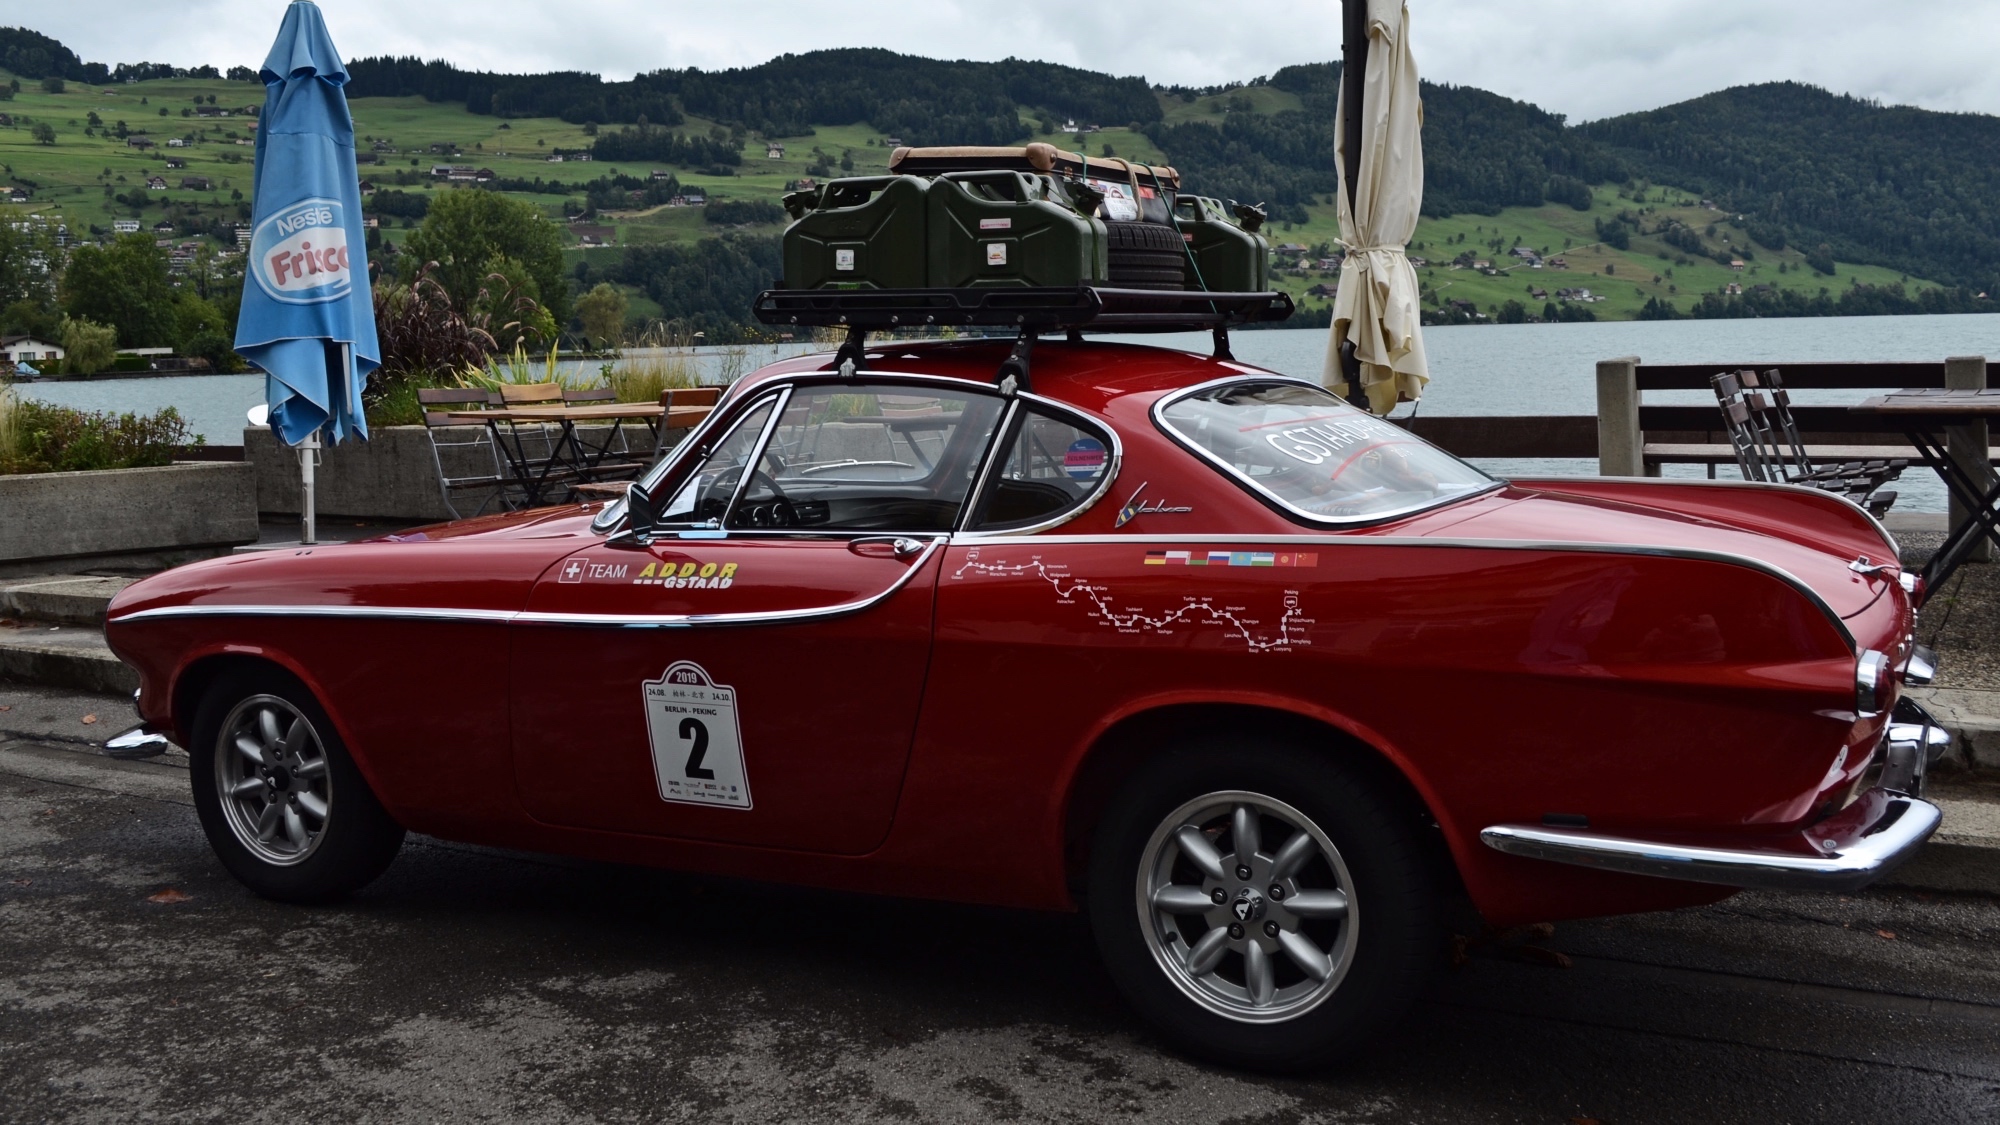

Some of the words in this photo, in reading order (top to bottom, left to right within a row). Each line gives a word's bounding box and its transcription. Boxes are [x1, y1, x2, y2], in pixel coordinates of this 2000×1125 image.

[276, 206, 333, 237] Nesté
[588, 564, 628, 578] TEAM
[638, 562, 739, 578] ADDOR
[663, 576, 733, 589] GSTAAD
[676, 671, 698, 684] 2019
[648, 688, 667, 697] 24.08.
[712, 692, 731, 702] 14.10.
[664, 705, 688, 714] BERLIN
[692, 707, 717, 716] PEKING
[678, 717, 715, 780] 2
